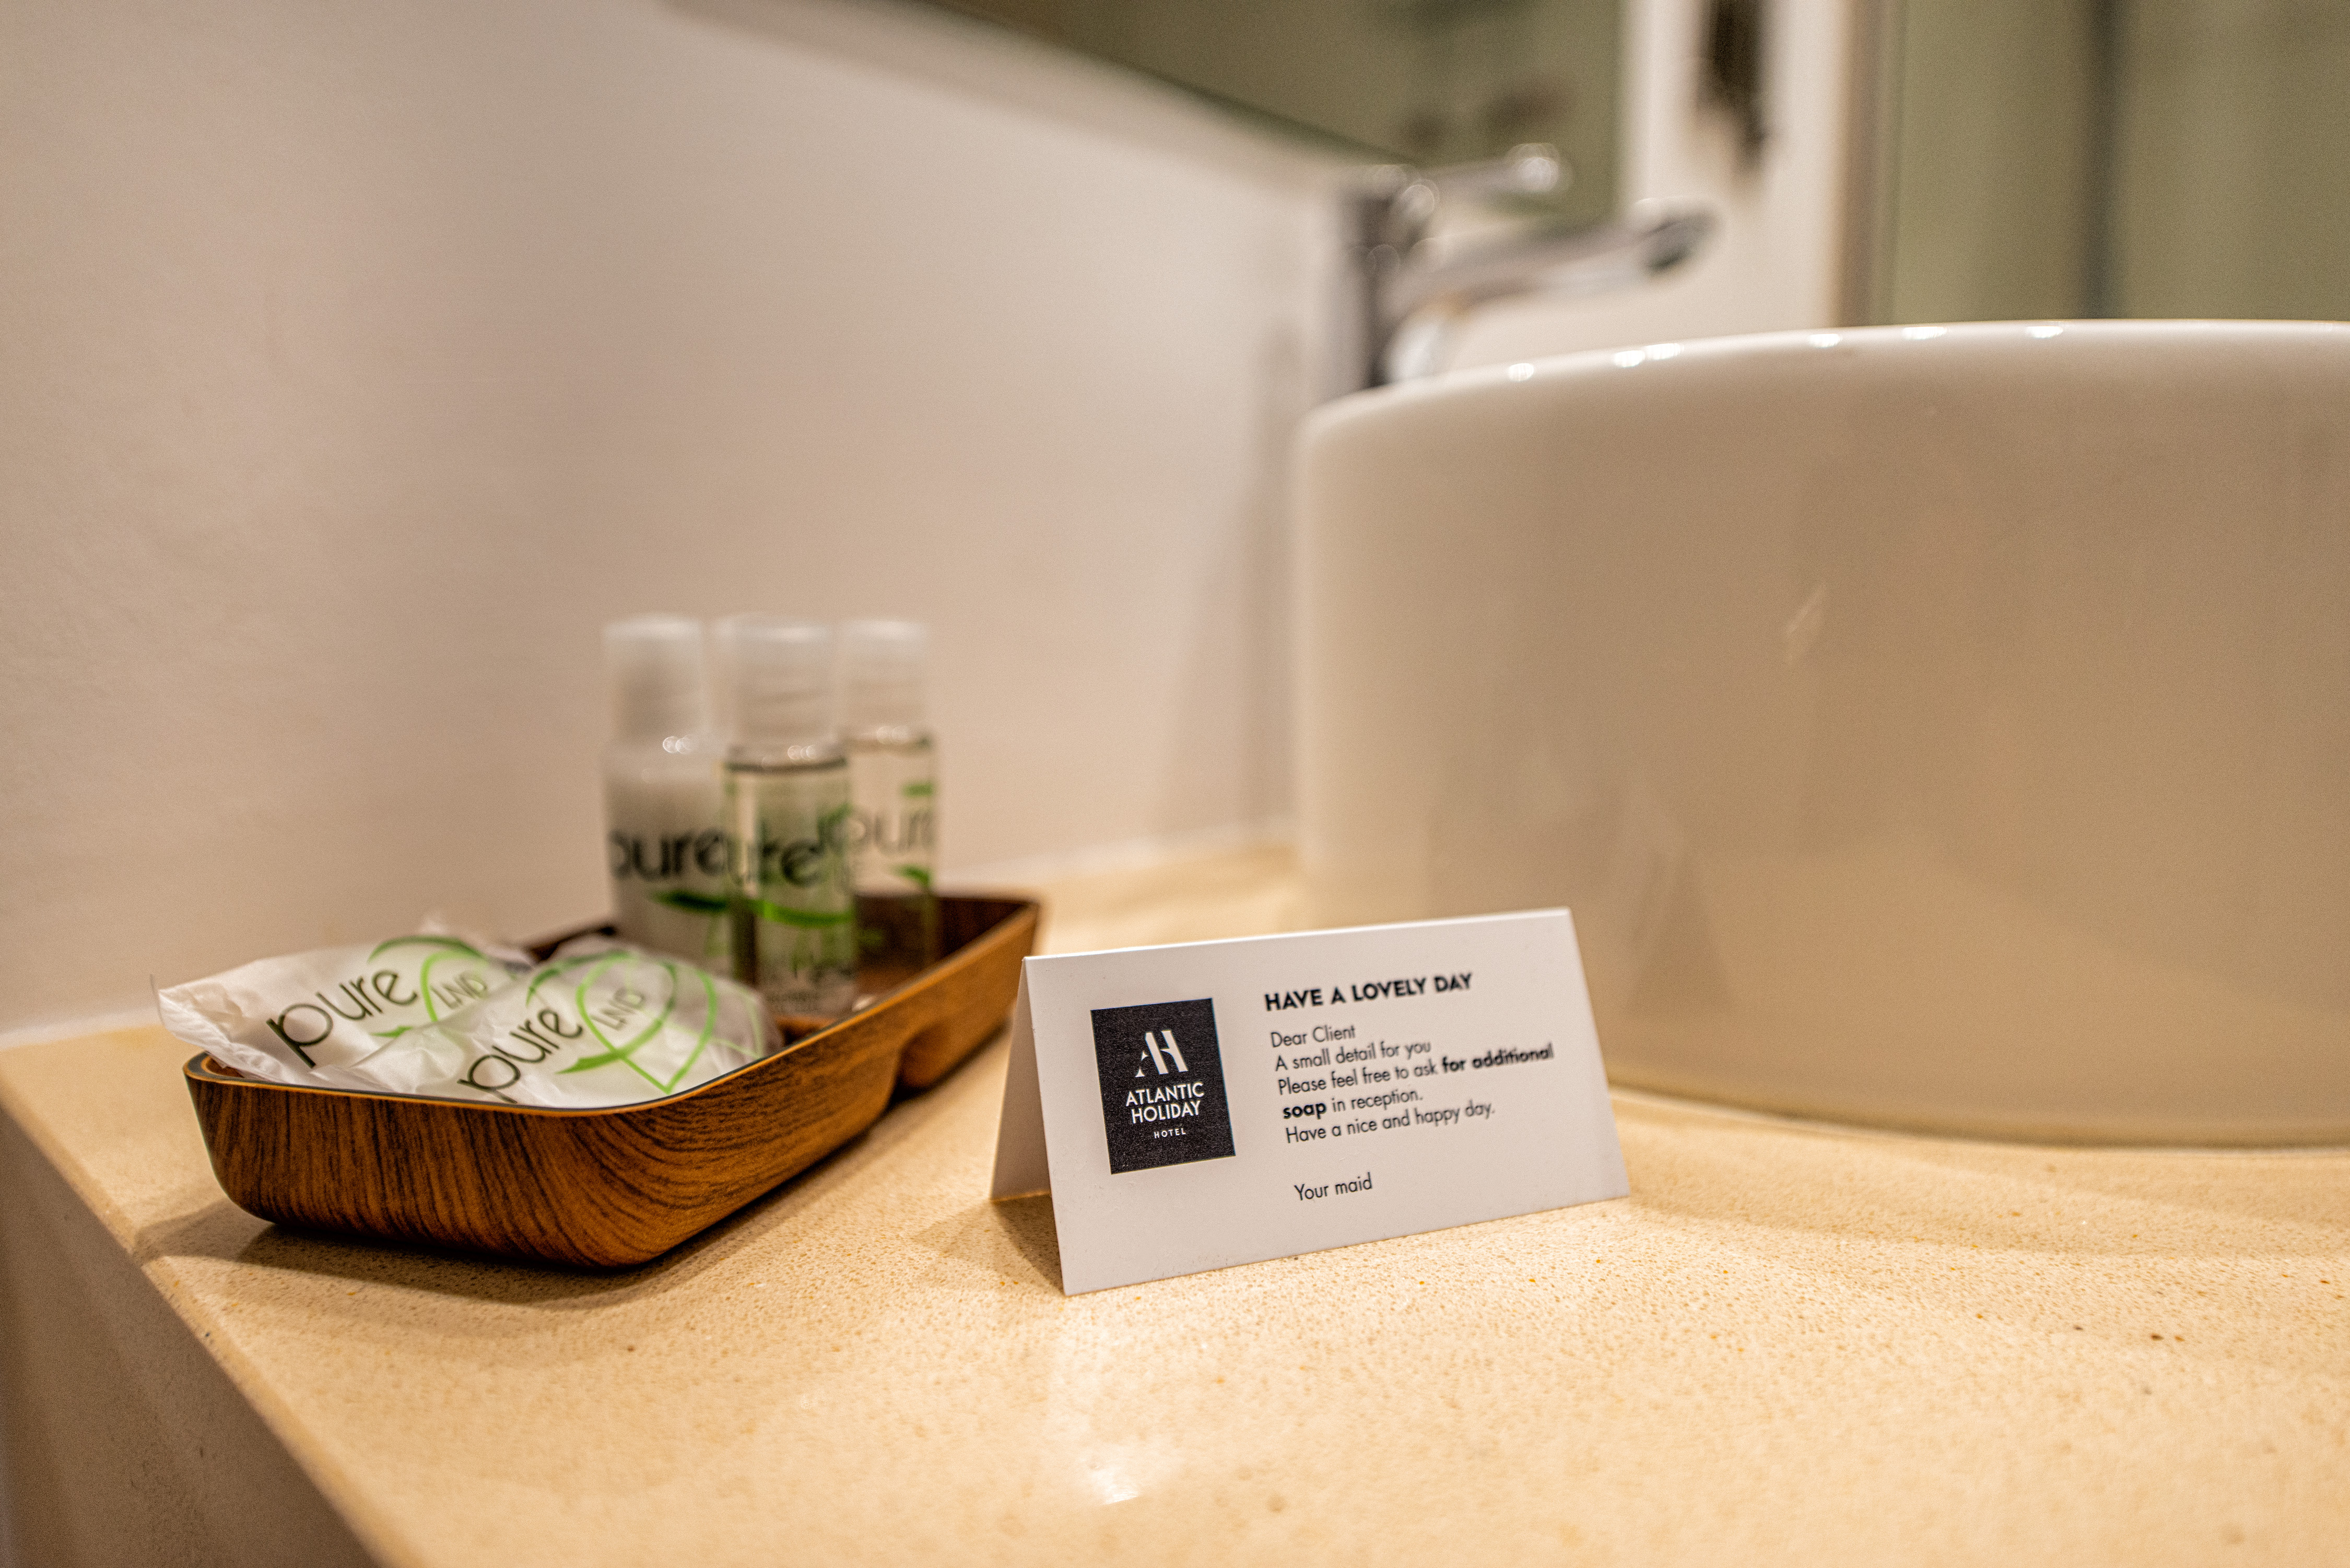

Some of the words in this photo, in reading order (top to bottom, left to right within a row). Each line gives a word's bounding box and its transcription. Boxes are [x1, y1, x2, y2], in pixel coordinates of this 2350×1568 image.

[1264, 988, 1323, 1012] HAVE
[1331, 986, 1347, 1005] A
[1351, 977, 1426, 1002] LOVELY
[1434, 972, 1472, 993] DAY
[266, 970, 418, 1069] pure
[1270, 1031, 1308, 1048] Dear
[1312, 1024, 1356, 1043] Client
[456, 1008, 583, 1104] pure
[1275, 1054, 1288, 1072] A
[1292, 1047, 1331, 1070] small
[1335, 1042, 1377, 1064] detail
[1380, 1041, 1400, 1058] for
[1404, 1043, 1431, 1060] you
[1277, 1077, 1326, 1095] Please
[1331, 1068, 1358, 1088] feel
[1361, 1067, 1391, 1084] free
[1395, 1066, 1409, 1079] to
[1413, 1058, 1437, 1077] ask
[1441, 1056, 1467, 1074] for
[1471, 1042, 1555, 1069] additional
[1125, 1082, 1205, 1107] ATLANTIC
[1283, 1101, 1327, 1120] soap
[1332, 1098, 1346, 1113] in
[1350, 1089, 1424, 1111] reception.
[1131, 1100, 1201, 1125] HOLIDAY
[1285, 1126, 1327, 1144] Have
[1331, 1125, 1342, 1137] a
[1346, 1119, 1378, 1135] nice
[1382, 1109, 1411, 1130] and
[1414, 1107, 1461, 1127] happy
[1464, 1099, 1496, 1120] day.
[1154, 1127, 1186, 1139] HOTEL
[1294, 1183, 1330, 1201] Your
[1334, 1171, 1373, 1196] maid
